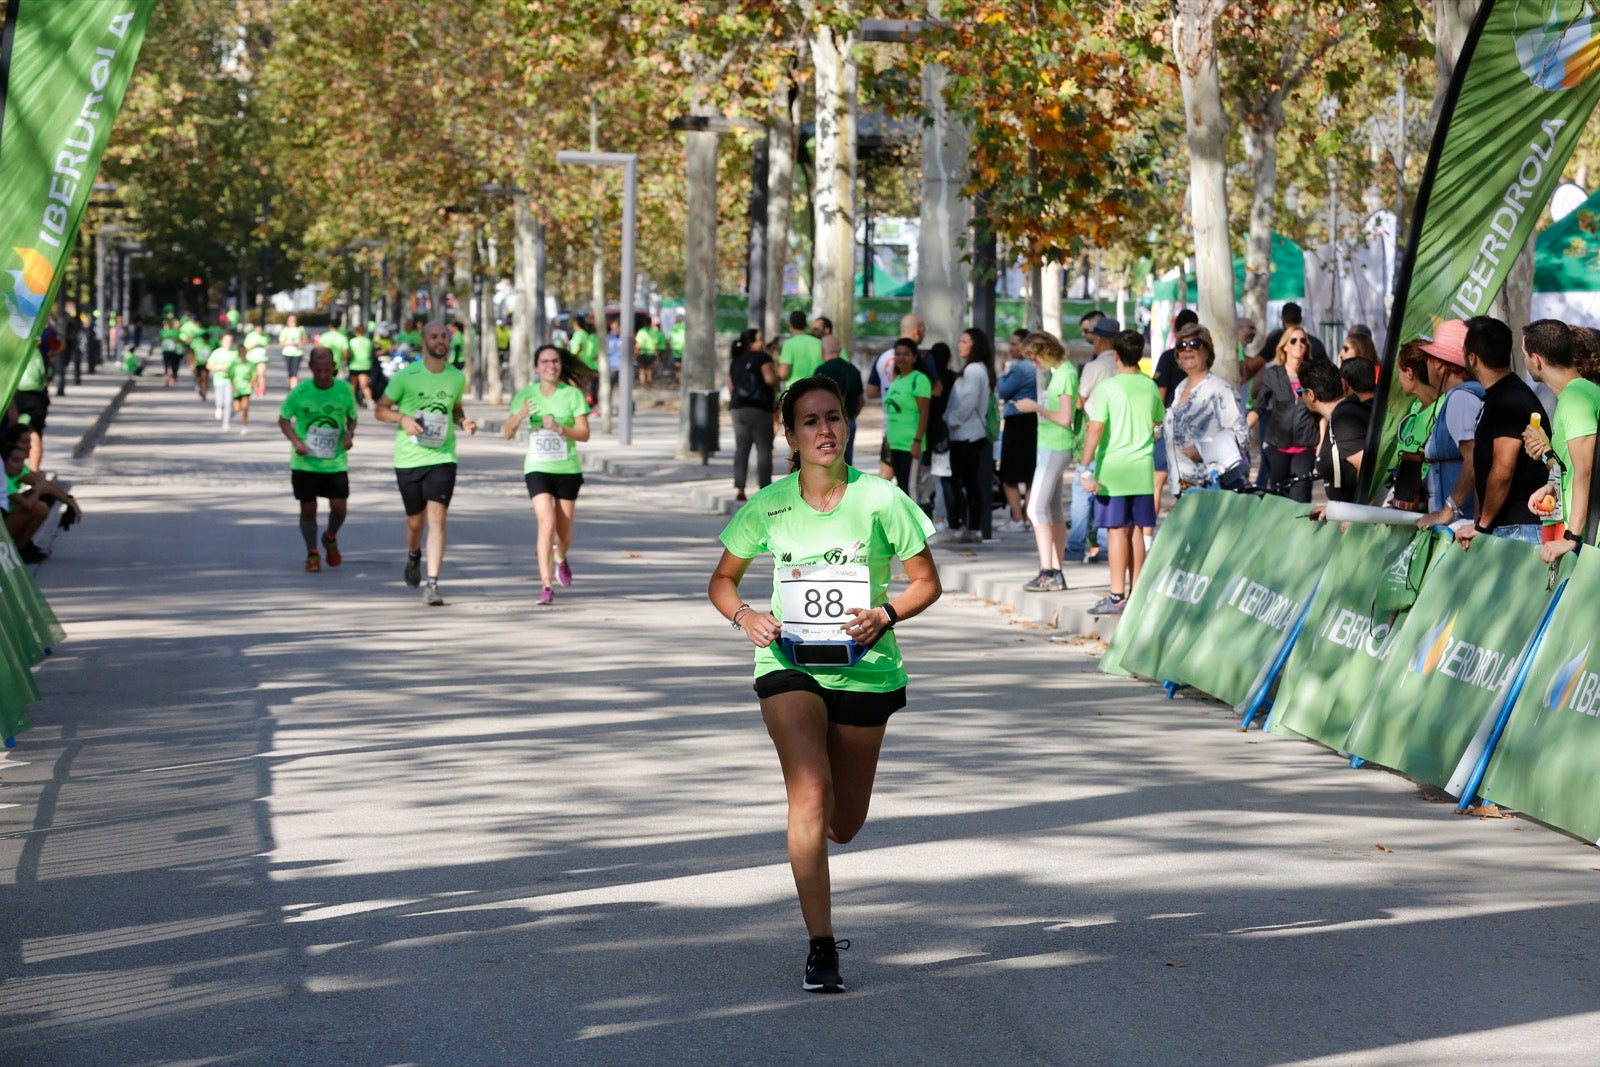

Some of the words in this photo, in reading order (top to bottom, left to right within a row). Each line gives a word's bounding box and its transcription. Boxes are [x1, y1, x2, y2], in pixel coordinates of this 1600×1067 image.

[1451, 118, 1568, 321] IBERDROLA
[311, 437, 336, 449] 460
[535, 438, 561, 452] 503
[804, 588, 844, 618] 88
[1437, 636, 1517, 692] BERDROLA
[1569, 670, 1600, 718] IBE
